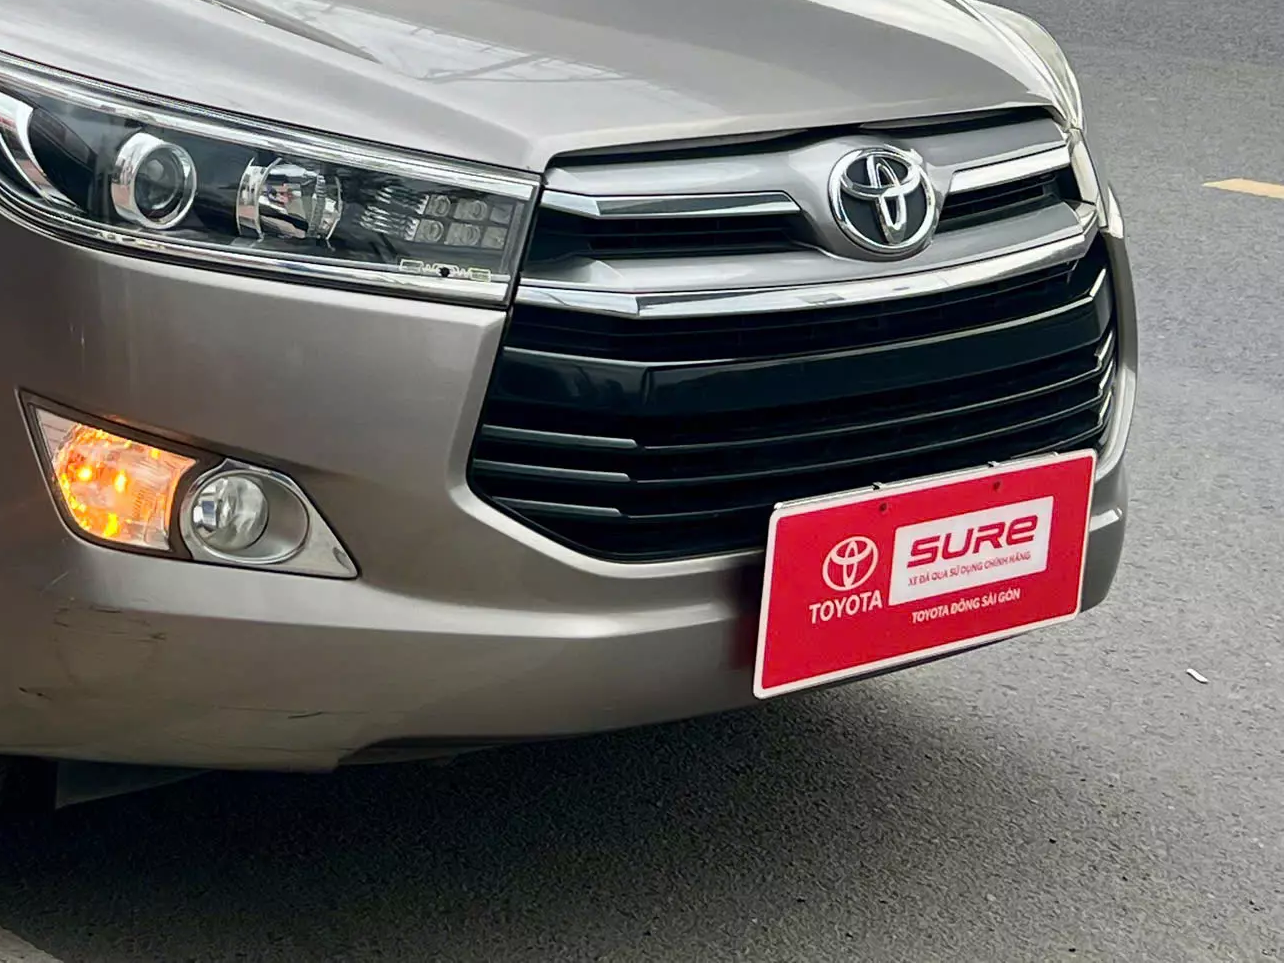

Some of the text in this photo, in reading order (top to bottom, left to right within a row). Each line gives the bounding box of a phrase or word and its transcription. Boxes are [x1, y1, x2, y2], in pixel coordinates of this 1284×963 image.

[907, 576, 918, 587] XE
[931, 571, 948, 582] QUA
[984, 555, 1009, 570] CHÍNH
[809, 590, 884, 625] TOYOTA
[911, 606, 950, 624] TOYOTA
[950, 597, 981, 614] ĐÔNG
